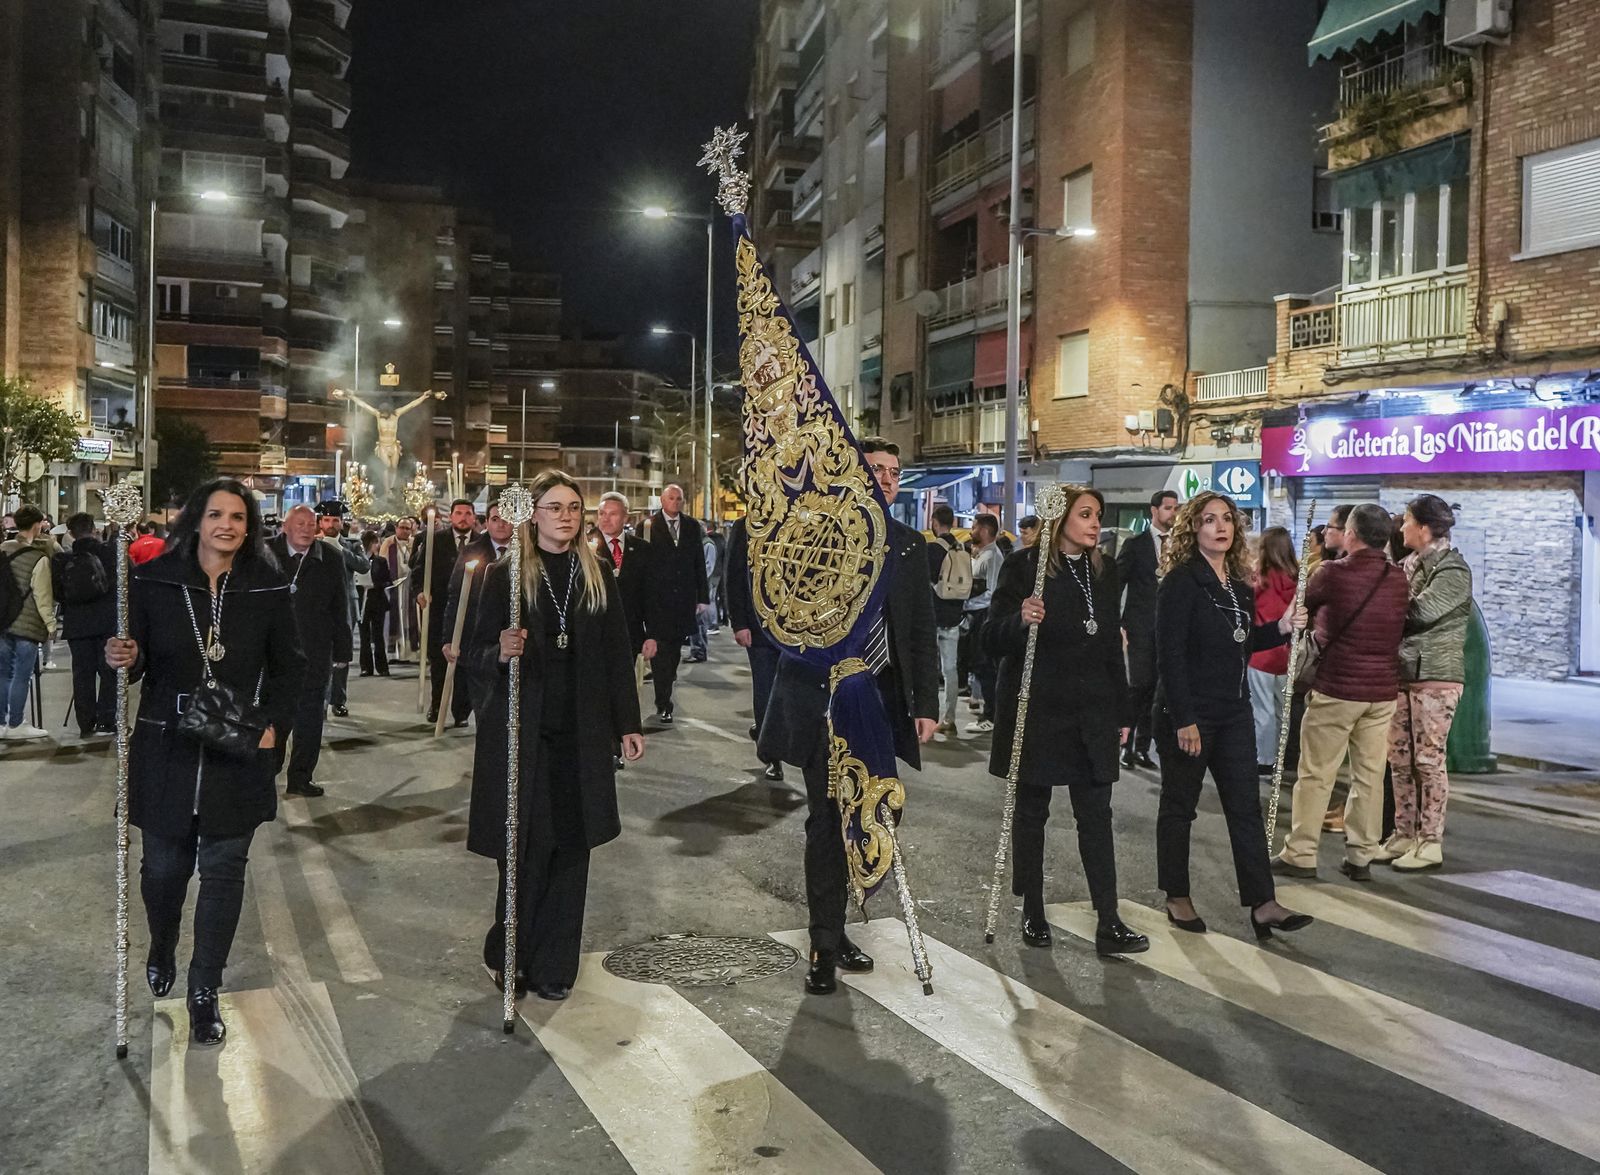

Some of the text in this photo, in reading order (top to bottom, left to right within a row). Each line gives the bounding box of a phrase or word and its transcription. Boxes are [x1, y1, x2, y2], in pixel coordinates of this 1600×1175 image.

[1315, 424, 1410, 459] Cafetería
[1411, 425, 1447, 463] Las
[1447, 421, 1525, 453] Niñas
[1527, 415, 1569, 451] del
